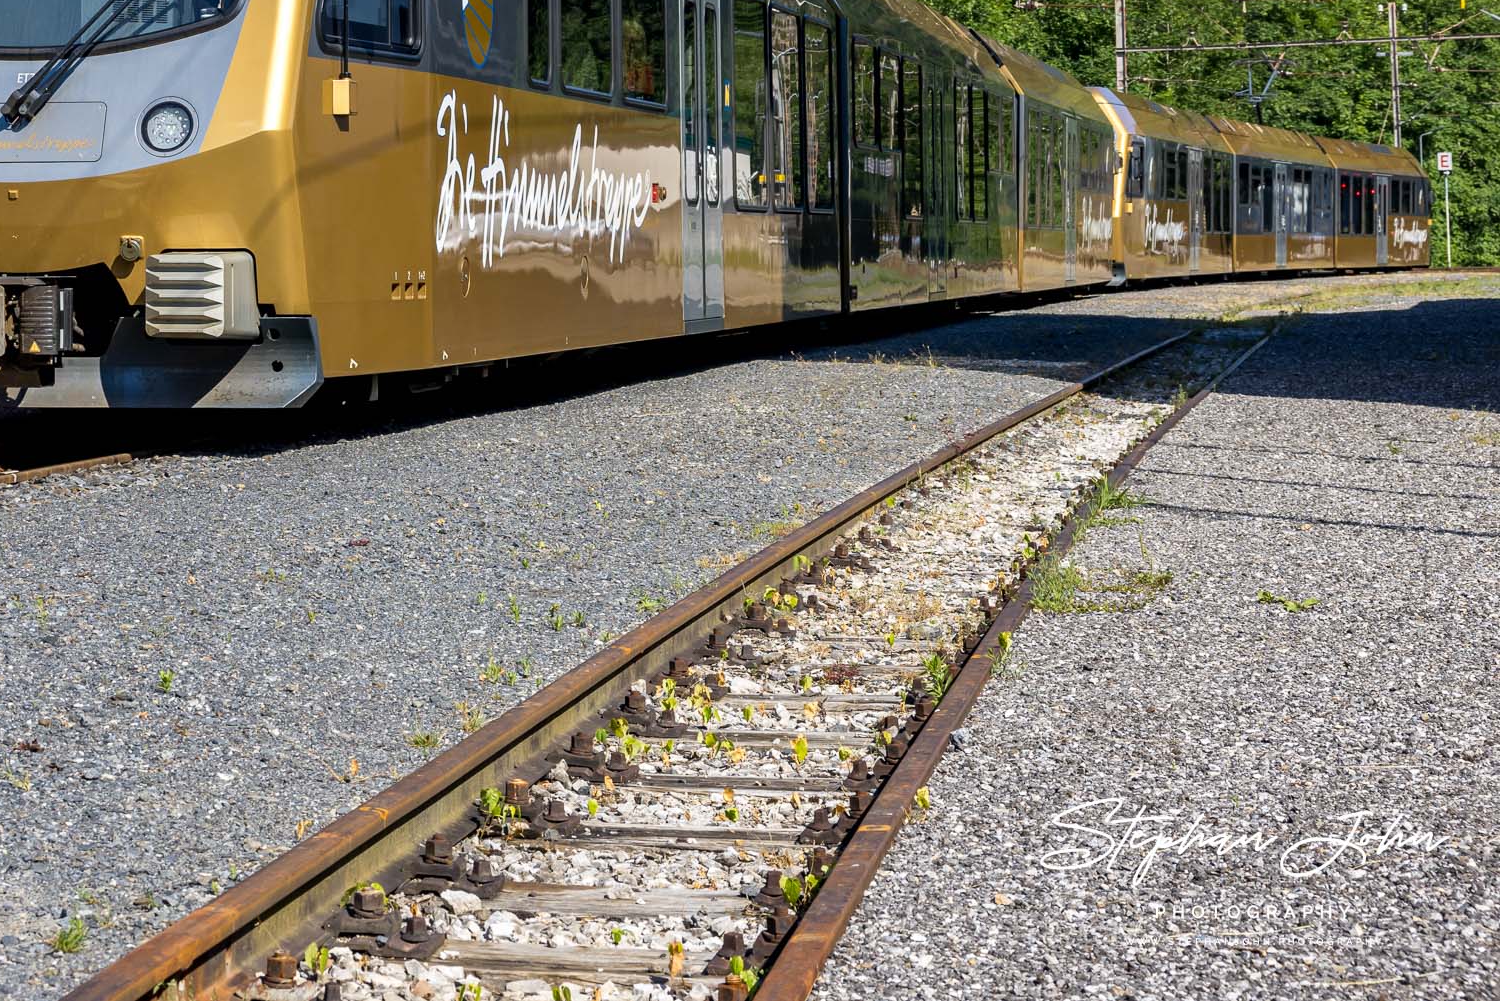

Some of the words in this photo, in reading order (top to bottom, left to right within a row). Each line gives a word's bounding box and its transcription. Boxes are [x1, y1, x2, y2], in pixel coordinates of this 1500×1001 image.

[436, 89, 477, 254] Die
[480, 94, 651, 269] Himmelstreppe
[1440, 154, 1450, 168] E
